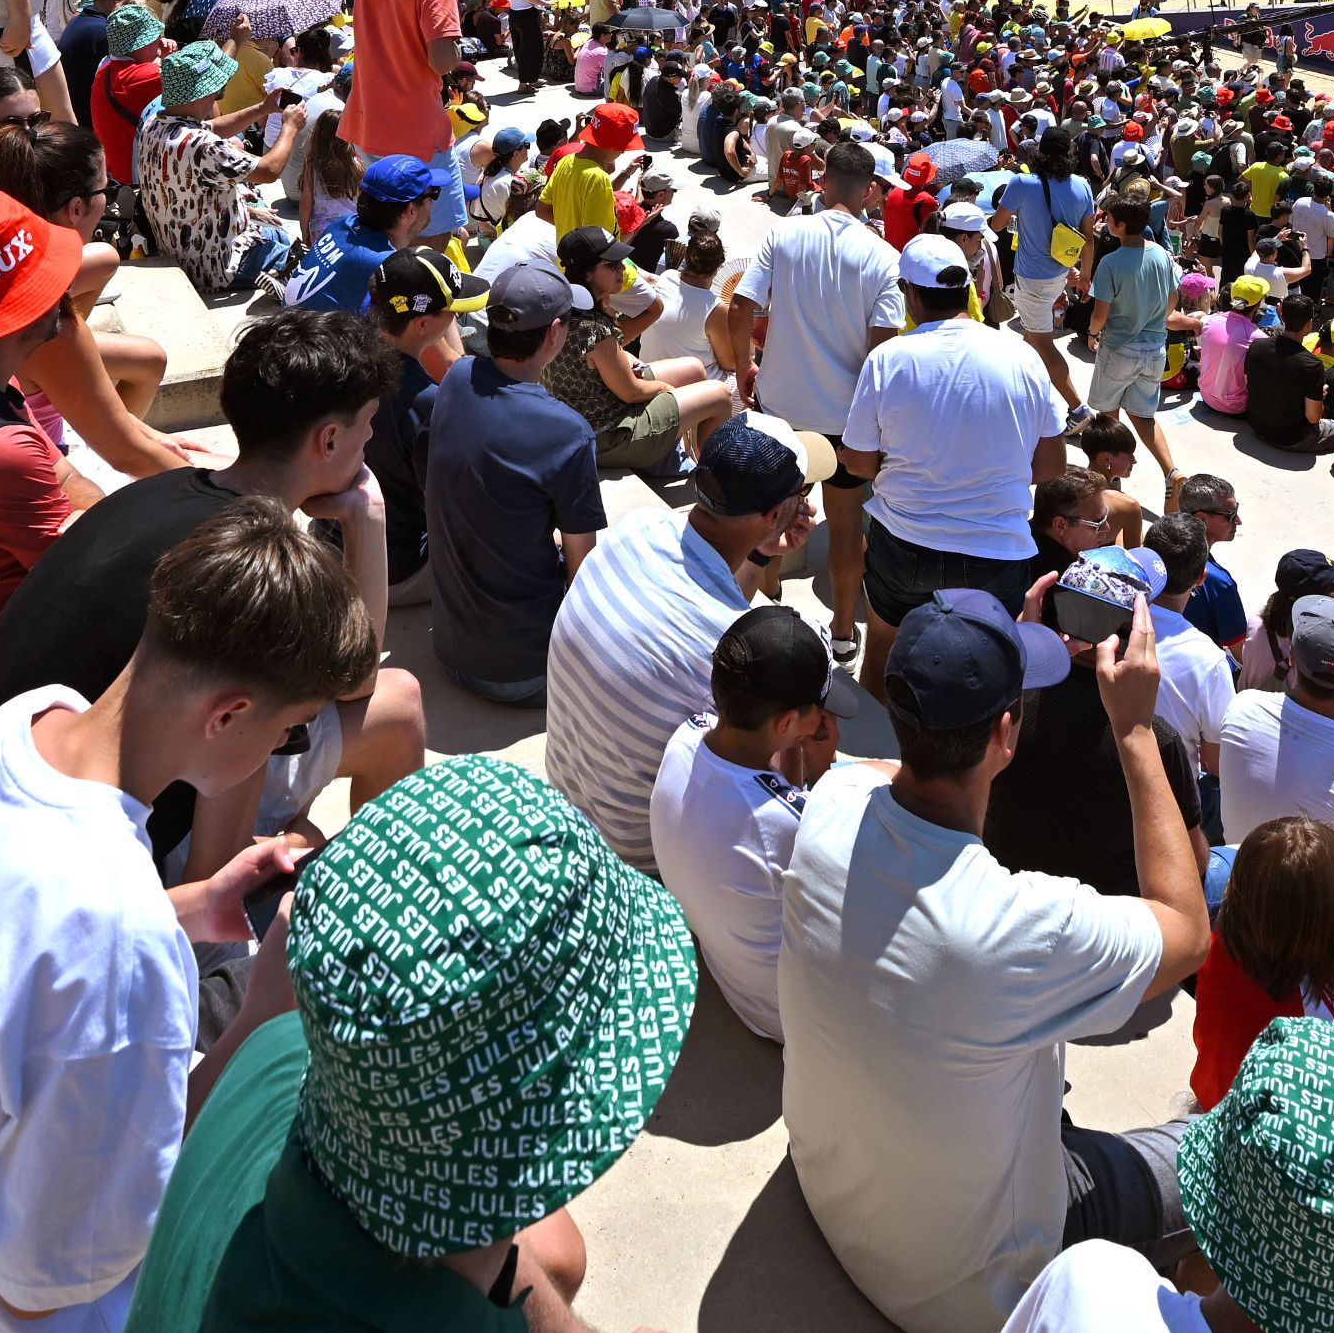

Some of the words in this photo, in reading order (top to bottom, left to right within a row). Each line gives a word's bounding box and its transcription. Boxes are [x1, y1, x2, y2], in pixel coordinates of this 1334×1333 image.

[318, 233, 344, 264] CDM
[426, 764, 477, 798] JULES
[467, 766, 522, 808] JULES
[387, 792, 437, 828] JULES
[427, 791, 482, 831] JULES
[472, 792, 531, 839] JULES
[347, 824, 398, 866] JULES
[386, 819, 442, 865] JULES
[431, 824, 492, 875] JULES
[477, 830, 542, 890] JULES
[311, 861, 359, 910] JULES
[348, 859, 403, 909] JULES
[391, 860, 453, 916] JULES
[436, 865, 504, 928] JULES
[313, 905, 364, 957] JULES
[353, 902, 413, 962] JULES
[398, 905, 466, 969] JULES
[403, 990, 483, 1044] JULES
[363, 1042, 441, 1068] JULES
[409, 1027, 488, 1083] JULES
[460, 1020, 538, 1084] JULES
[639, 1006, 664, 1089] JULES
[369, 1072, 452, 1108] JULES
[1273, 1062, 1332, 1092] JULES
[420, 1075, 502, 1124] JULES
[511, 1099, 592, 1130] JULES
[1270, 1095, 1326, 1128] JULES
[380, 1121, 462, 1148] JULES
[462, 1134, 549, 1159] JULES
[556, 1127, 641, 1155] JULES
[377, 1168, 452, 1210] JULES
[415, 1154, 498, 1188] JULES
[507, 1161, 594, 1189] JULES
[1178, 1170, 1206, 1207] JULES
[339, 1174, 407, 1227] JULES
[459, 1193, 546, 1219] JULES
[412, 1213, 495, 1246] JULES
[1183, 1203, 1222, 1242] JULES
[1225, 1241, 1274, 1284] JULES
[1272, 1241, 1330, 1277] JULES
[1222, 1278, 1267, 1319] JULES
[1246, 1275, 1302, 1317] JULES
